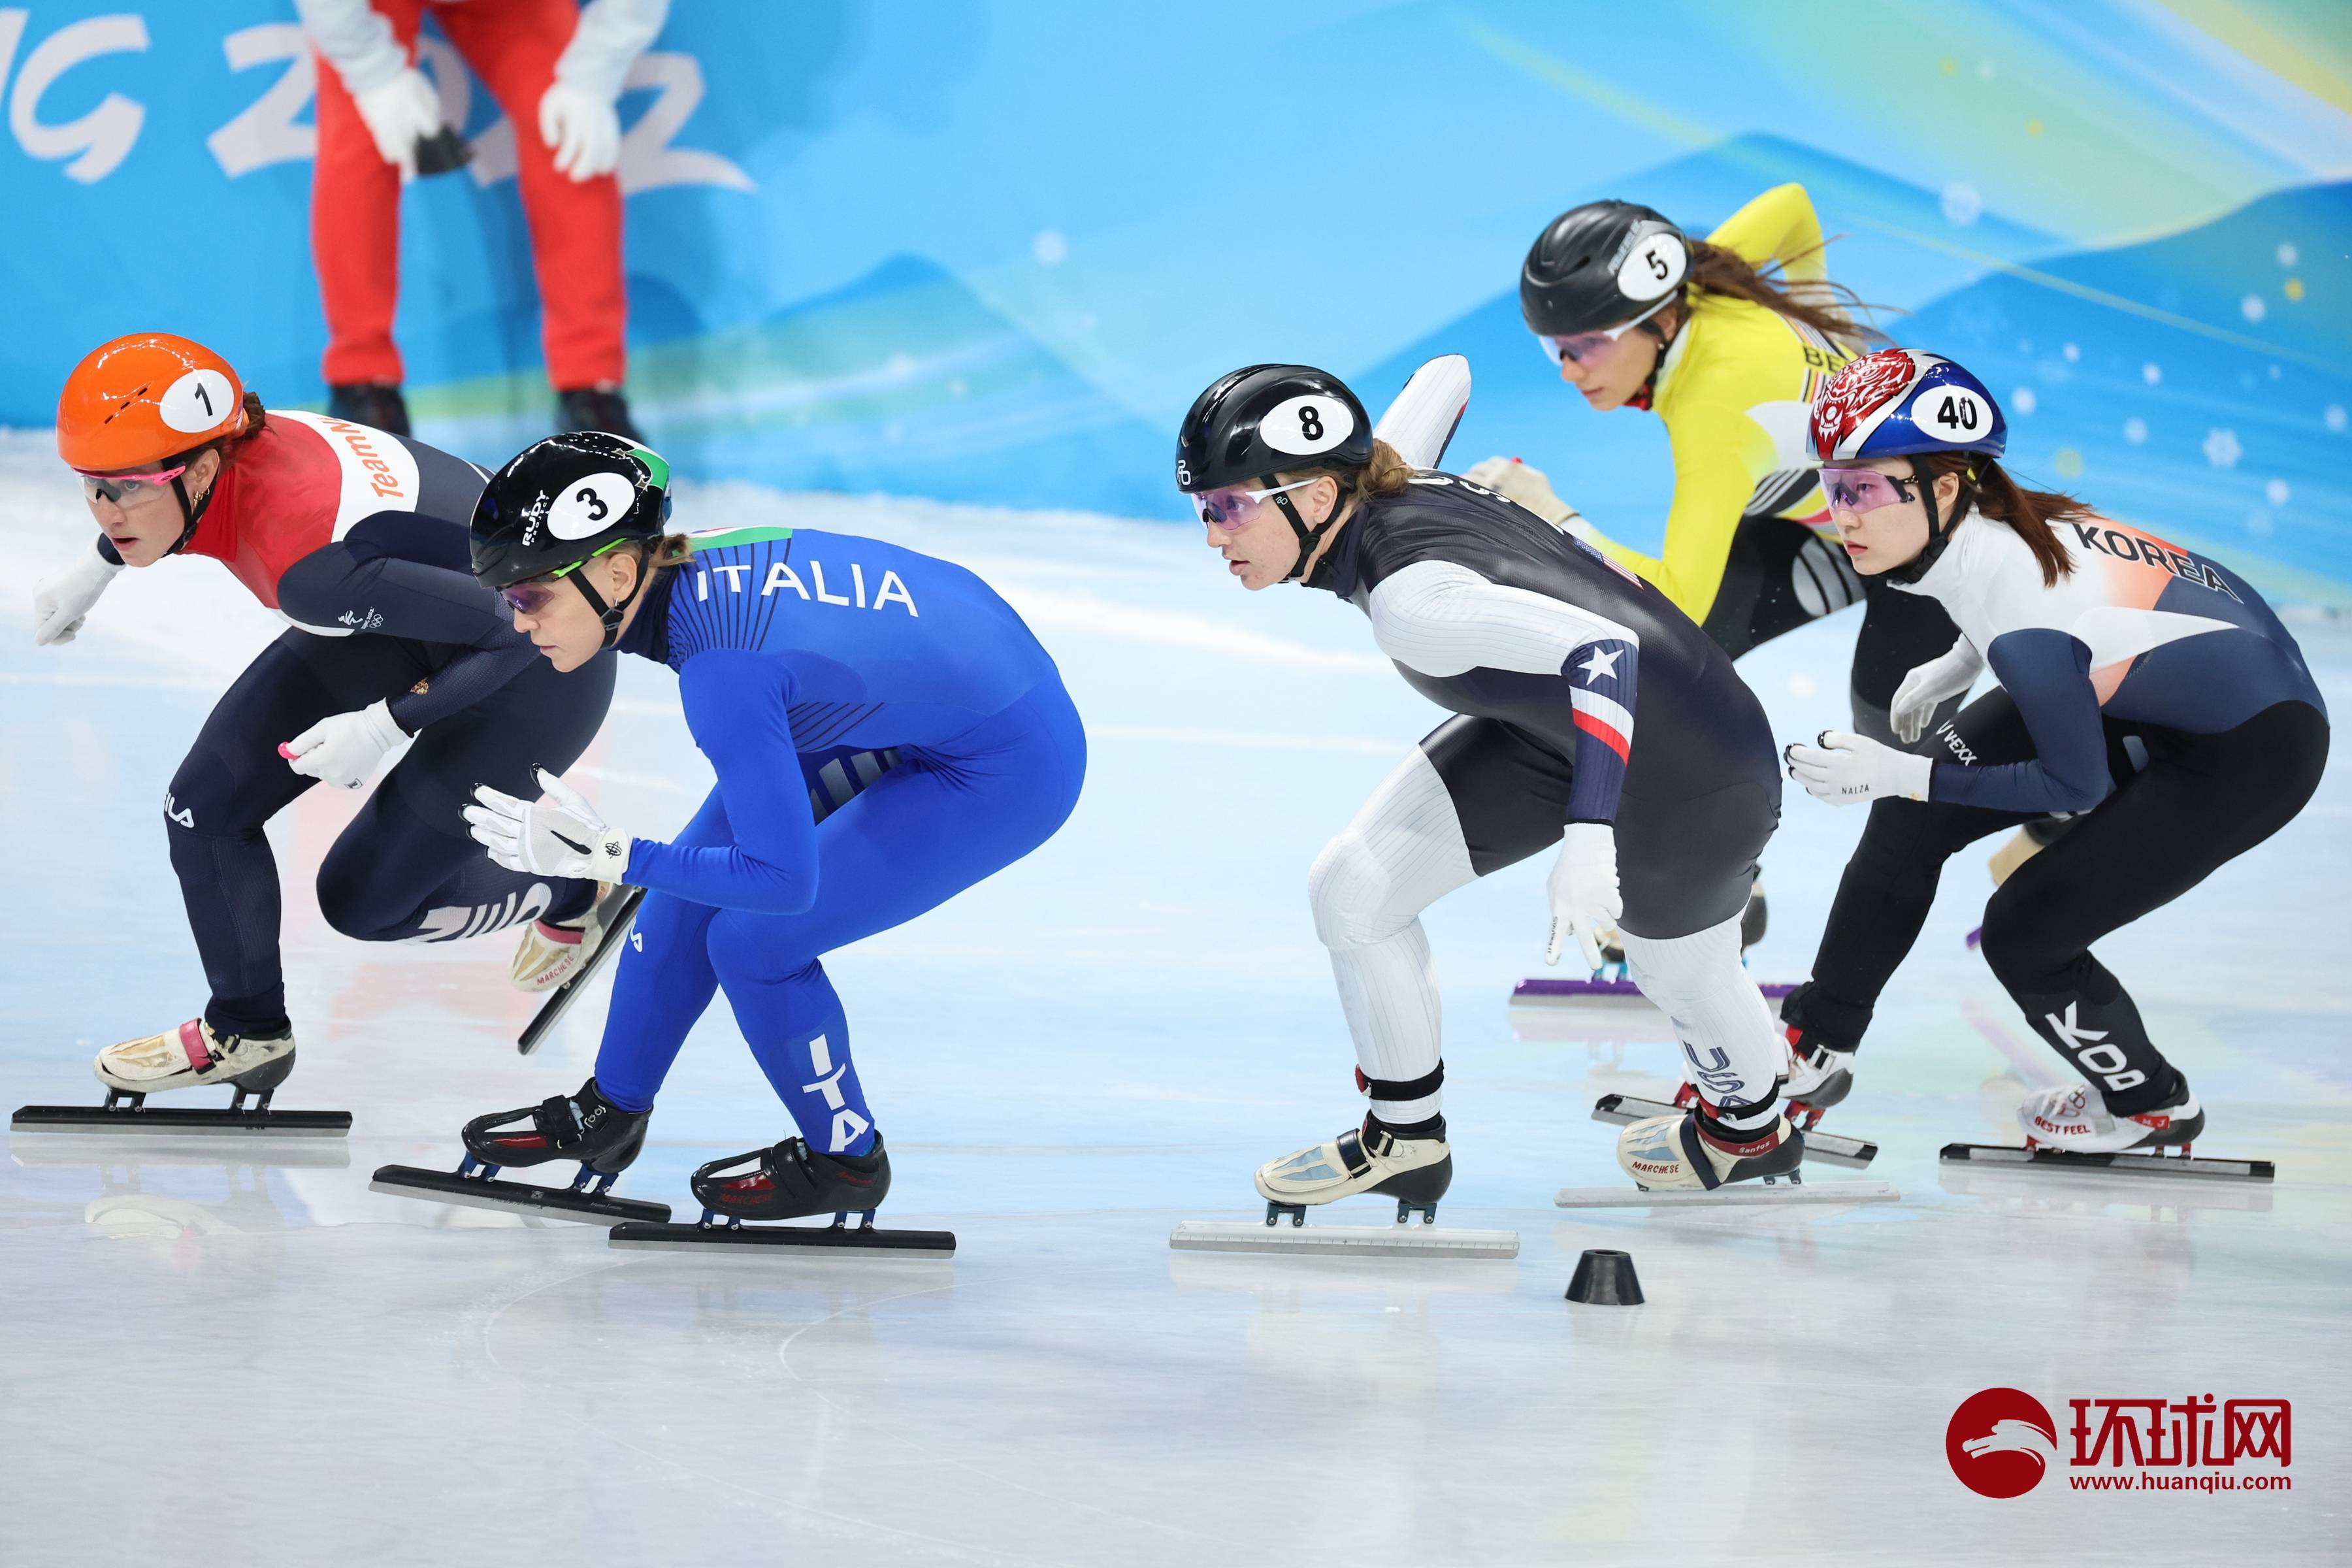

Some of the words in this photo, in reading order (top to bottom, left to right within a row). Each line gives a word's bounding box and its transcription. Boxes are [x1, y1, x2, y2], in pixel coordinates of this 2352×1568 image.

[1646, 250, 1668, 280] 5
[195, 383, 212, 416] 1
[1937, 395, 1978, 431] 40
[1298, 406, 1324, 441] 8
[522, 489, 546, 546] RUDY
[576, 487, 608, 521] 3
[2071, 523, 2244, 604] KOREA
[696, 560, 919, 617] ITALIA
[1842, 784, 1869, 794] NALZA
[1682, 1039, 1754, 1108] USA
[802, 1033, 870, 1152] ITA
[2034, 1116, 2059, 1134] BEST
[2063, 1124, 2090, 1135] FEEL
[1739, 1141, 1771, 1154] Santos
[1631, 1161, 1680, 1174] MARCHESE
